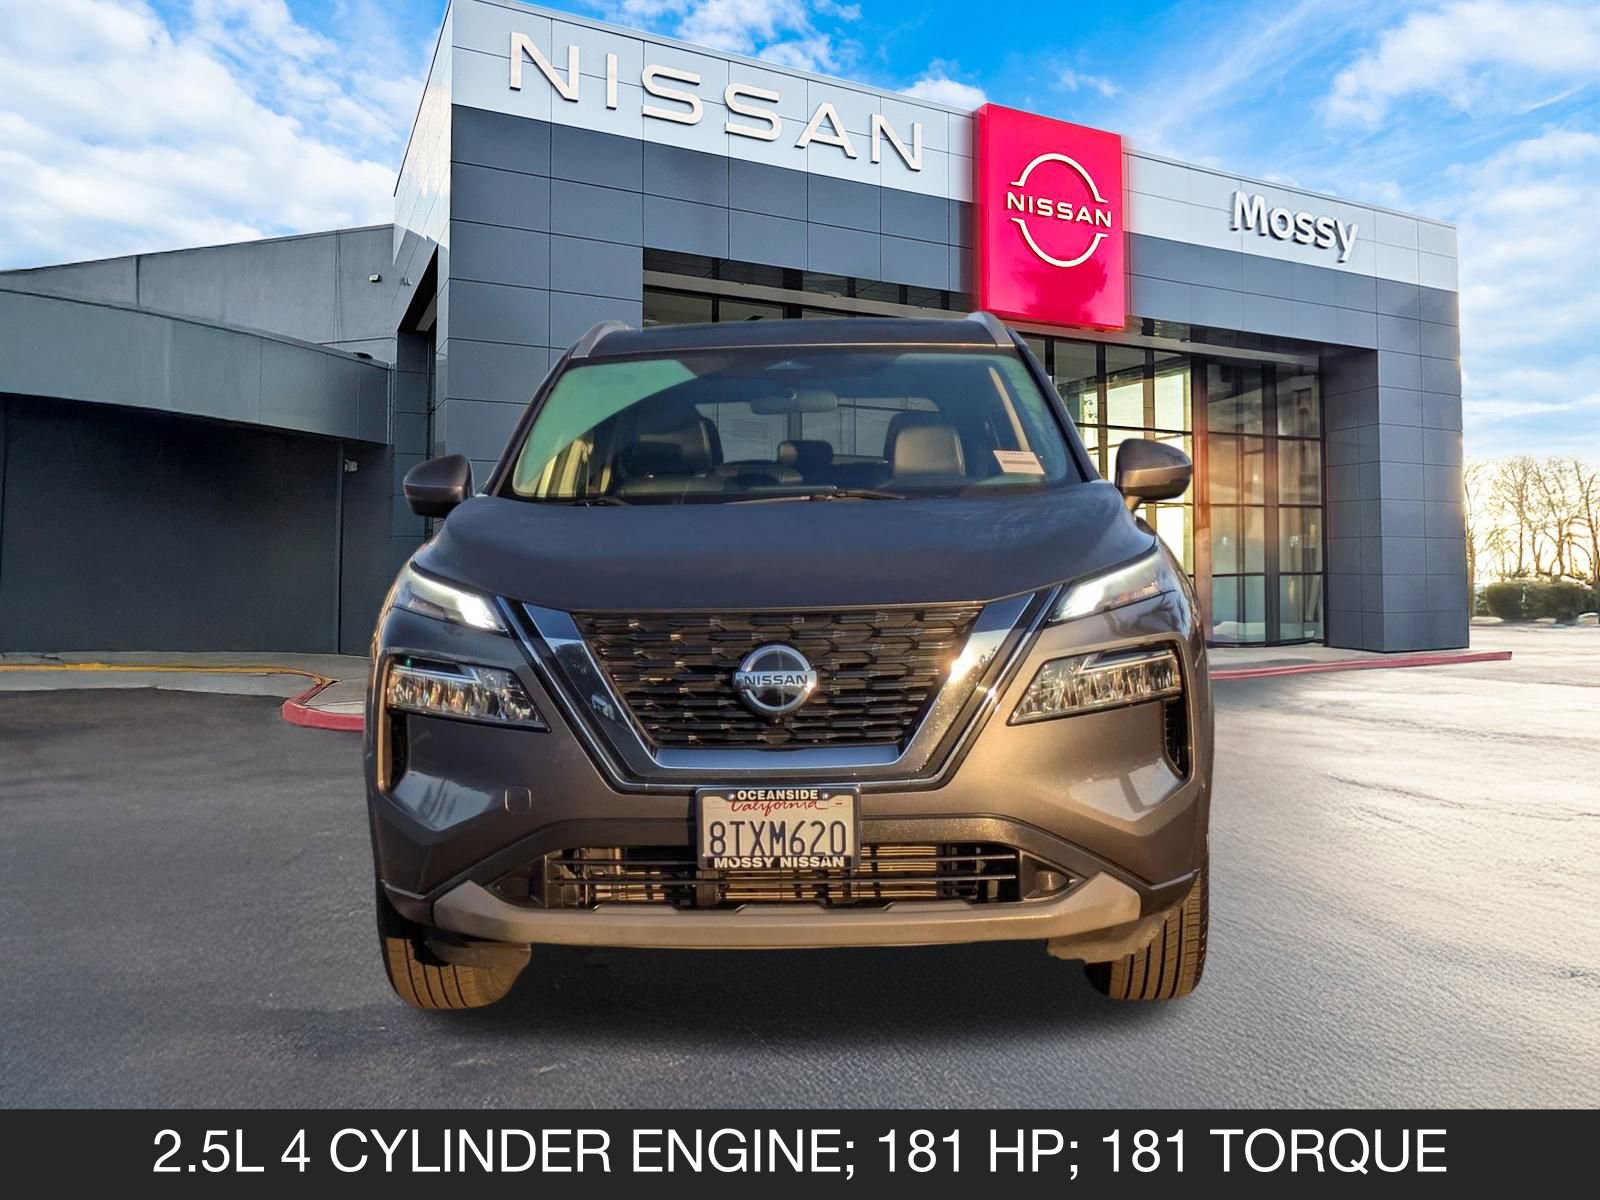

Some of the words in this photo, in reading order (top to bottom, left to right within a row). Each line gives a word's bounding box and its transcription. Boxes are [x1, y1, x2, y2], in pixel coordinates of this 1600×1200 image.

[509, 31, 923, 172] NISSAN
[1006, 191, 1112, 228] NISSAN
[1230, 190, 1361, 263] Mossy
[744, 674, 808, 686] NISSAN
[737, 789, 819, 801] OCEANSIDE
[709, 820, 847, 857] 8TXM620
[714, 857, 774, 868] MOSSY
[780, 857, 844, 868] NISSAN
